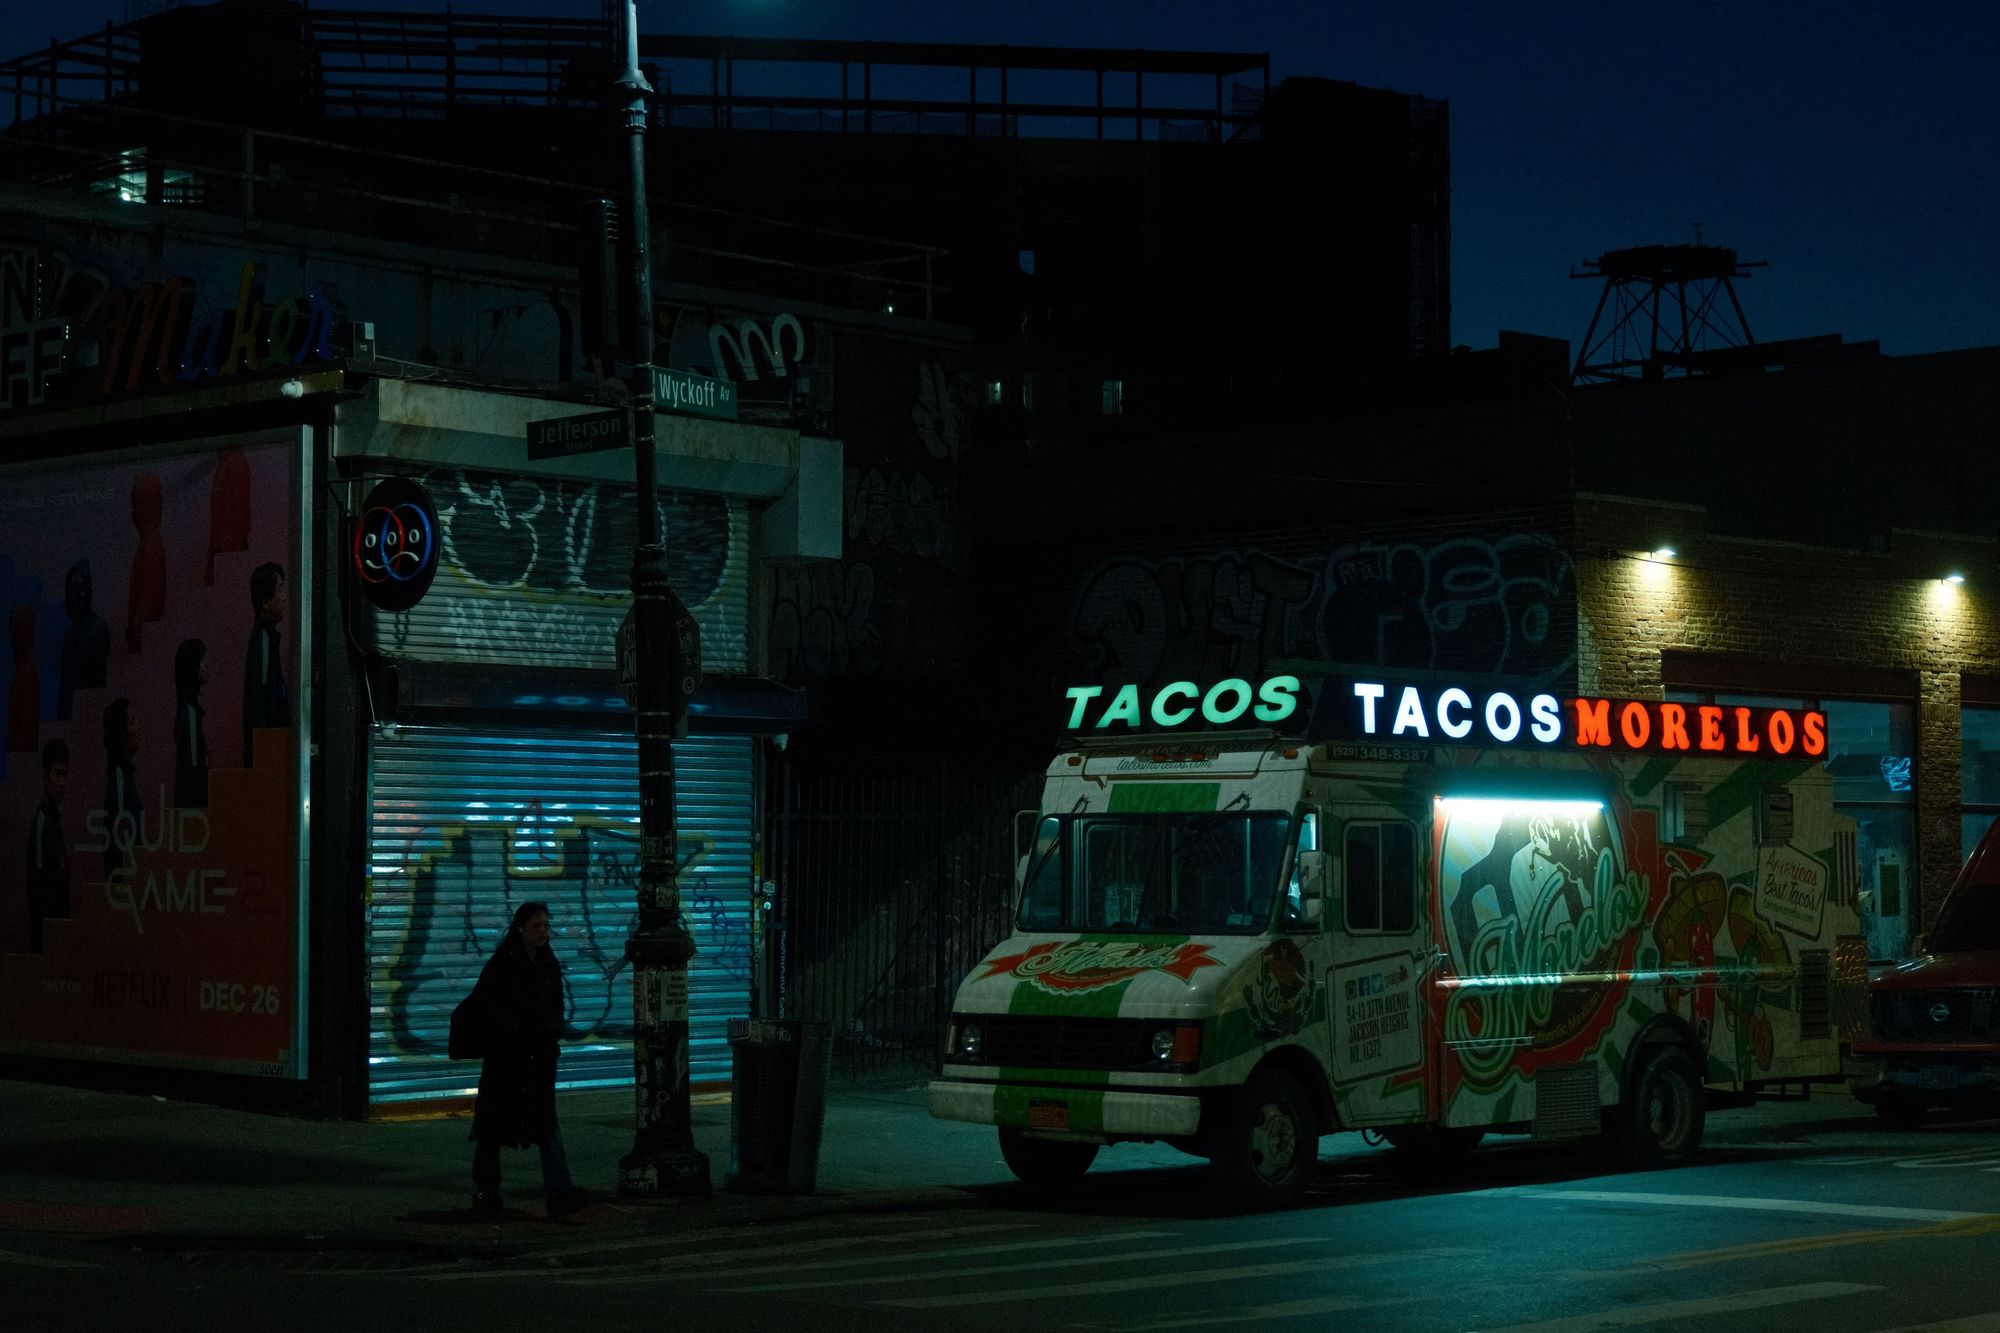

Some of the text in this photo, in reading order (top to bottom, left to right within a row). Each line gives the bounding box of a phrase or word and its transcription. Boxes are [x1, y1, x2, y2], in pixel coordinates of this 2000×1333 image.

[102, 260, 338, 396] Maker
[659, 373, 715, 408] Wyckoff
[536, 416, 622, 445] Jefferson
[566, 440, 593, 452] Street
[1065, 675, 1300, 729] TACOS
[1353, 682, 1826, 757] TACOS MORELOS
[1359, 747, 1429, 761] 348-8387
[75, 782, 210, 853] SQUID
[106, 866, 237, 935] GAME
[1445, 846, 1650, 1092] Morelos
[95, 971, 171, 1009] NETFLIX
[200, 981, 245, 1011] DEC
[251, 984, 280, 1015] 26
[1385, 991, 1410, 1013] AVENUE
[1349, 1011, 1409, 1043] JACKSON HEIGHTS
